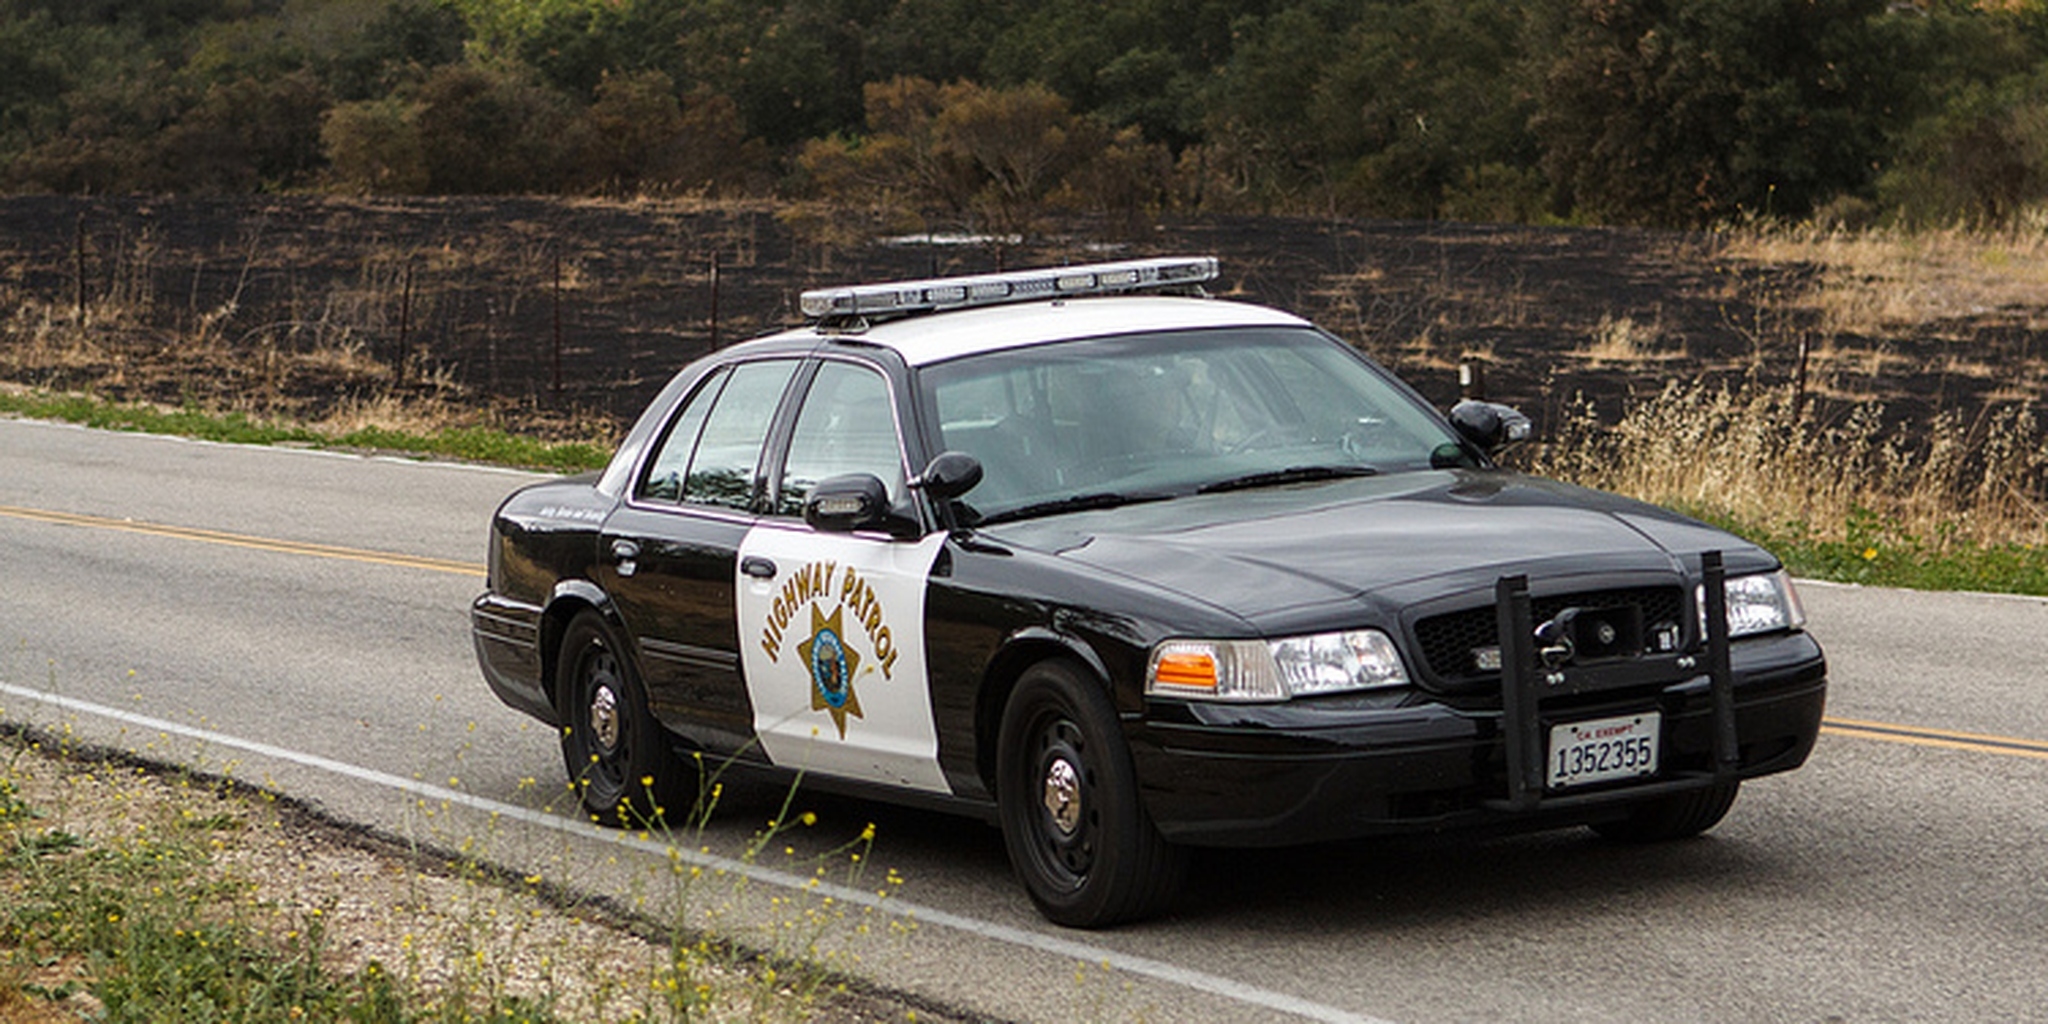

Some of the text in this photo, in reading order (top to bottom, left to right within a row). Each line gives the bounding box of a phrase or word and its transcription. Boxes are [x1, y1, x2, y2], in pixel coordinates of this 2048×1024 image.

[761, 561, 836, 663] HIGHWAY
[841, 566, 898, 681] PATROL
[1576, 724, 1634, 741] CA EXEMPT
[1555, 737, 1652, 778] 1352355
